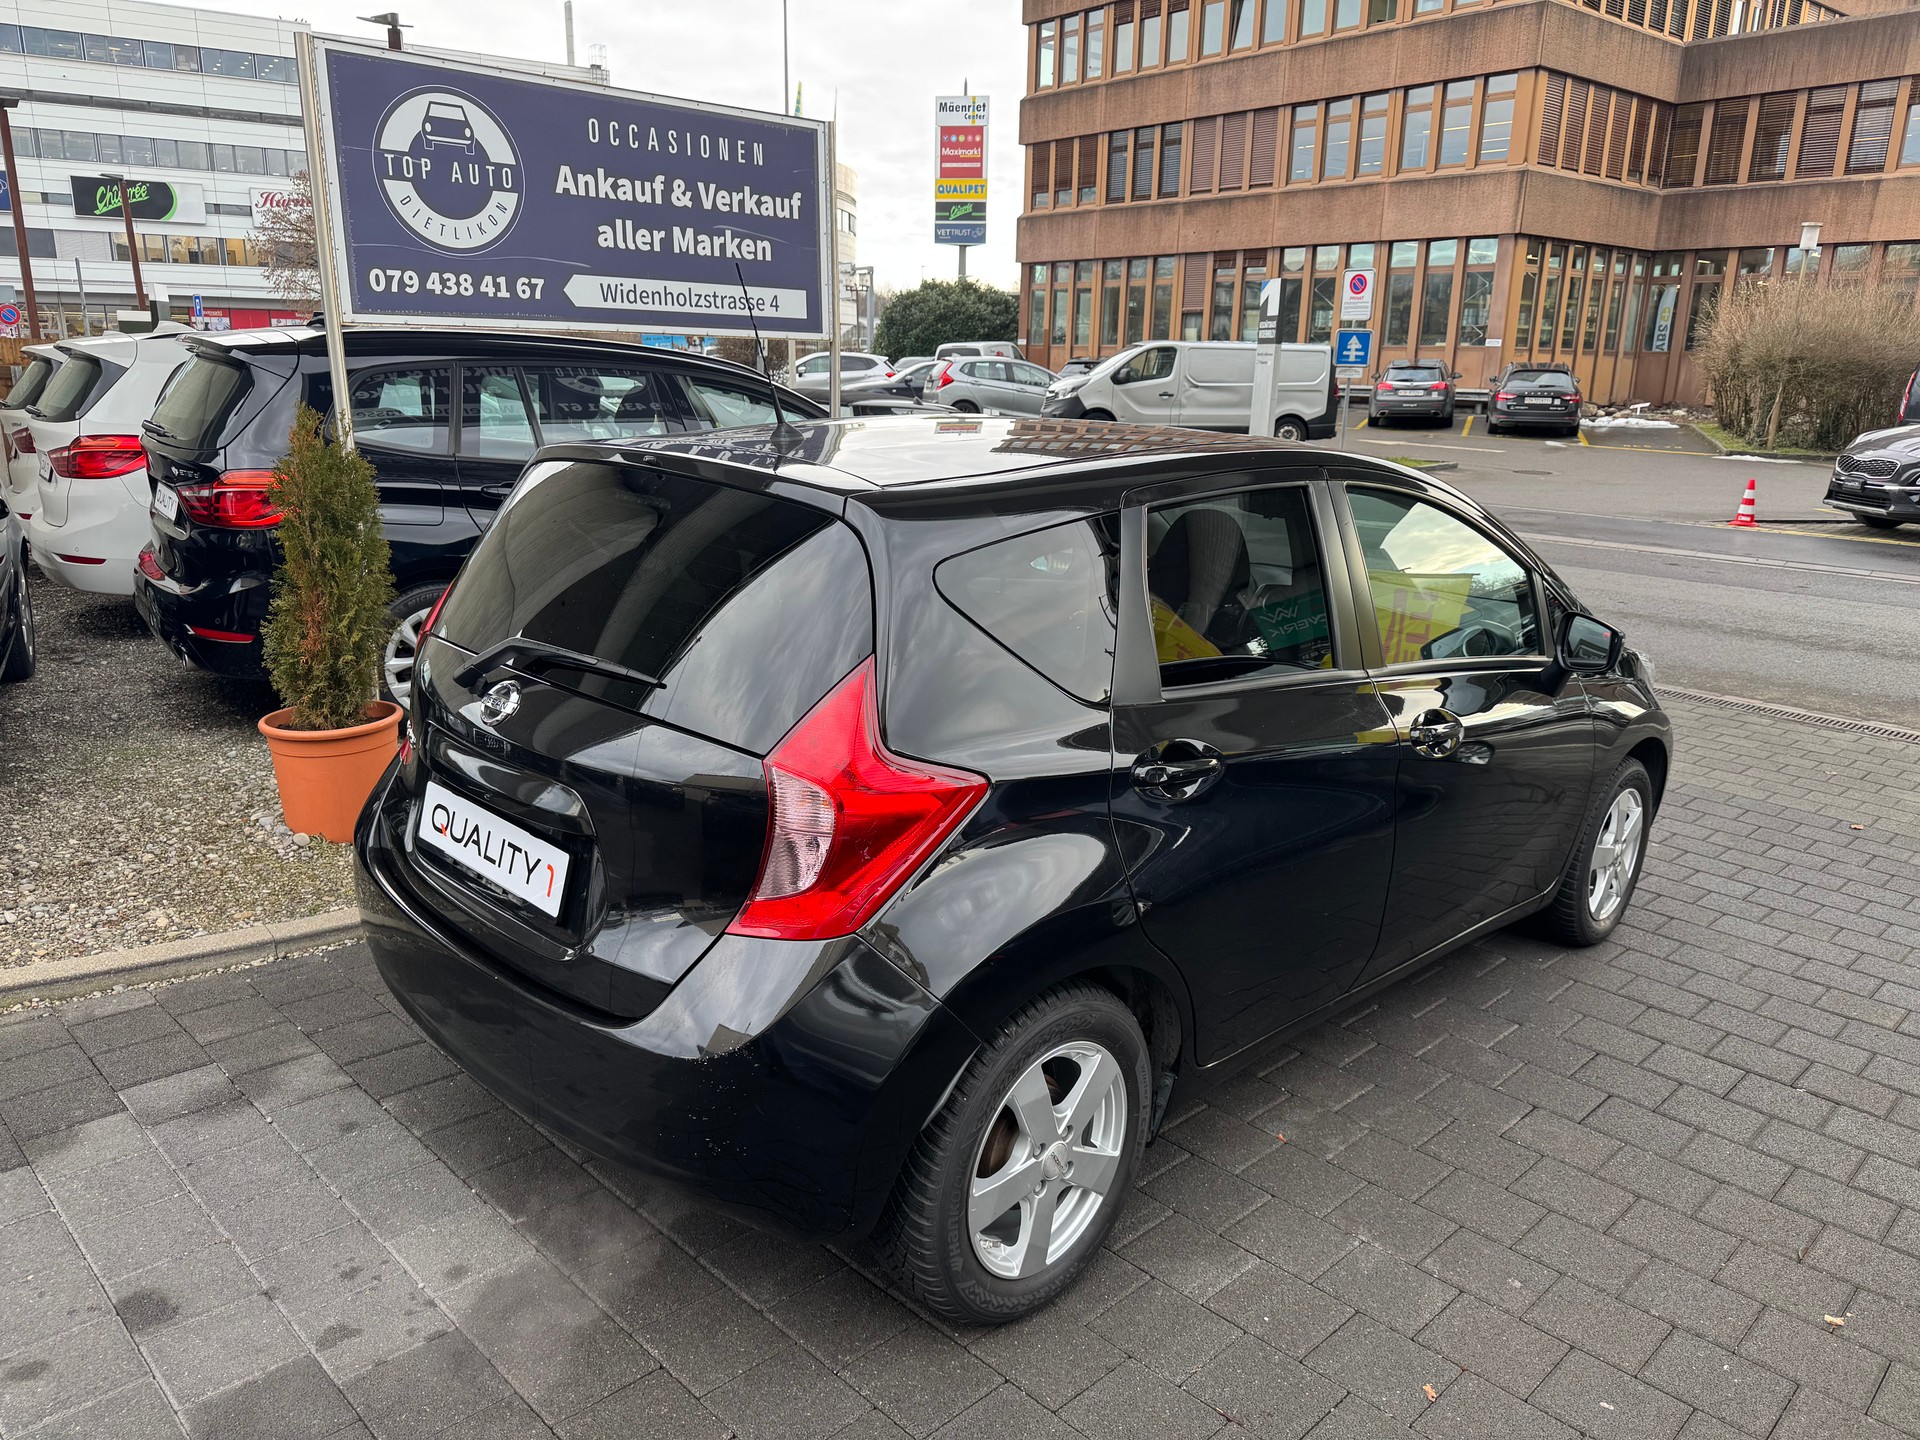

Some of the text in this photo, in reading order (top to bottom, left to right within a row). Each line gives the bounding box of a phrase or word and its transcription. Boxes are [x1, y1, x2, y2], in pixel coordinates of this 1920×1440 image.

[588, 118, 763, 166] OCCASIONEN
[942, 147, 981, 156] Maximarkt
[384, 153, 512, 188] TOP AUTO
[937, 184, 986, 194] QUALIPET
[555, 165, 801, 220] Ankauf & Verkauf
[400, 195, 508, 240] DIETLIKON
[597, 218, 772, 261] aller Marken
[369, 268, 545, 299] 079 438 41 67
[600, 282, 779, 312] Widenholzstrasse 4
[432, 803, 555, 897] QUALITY 1
